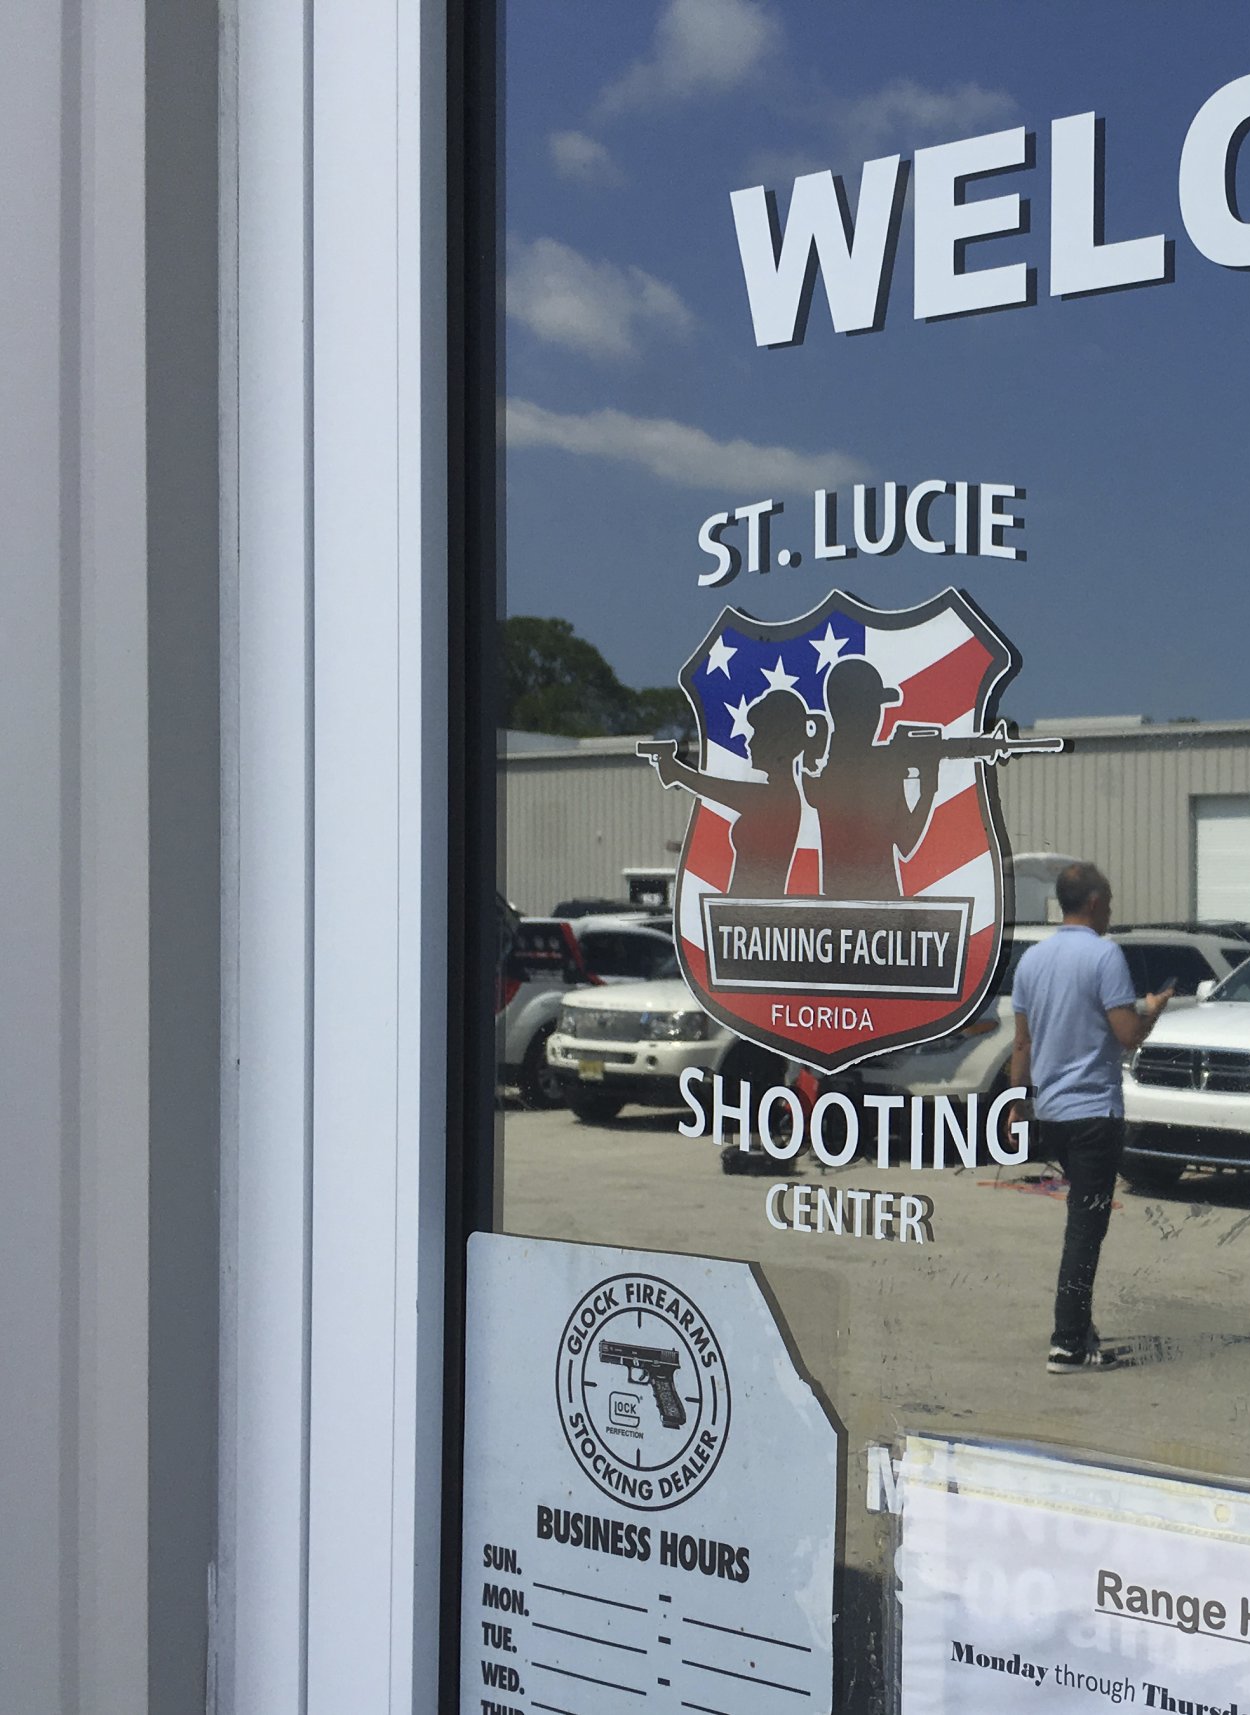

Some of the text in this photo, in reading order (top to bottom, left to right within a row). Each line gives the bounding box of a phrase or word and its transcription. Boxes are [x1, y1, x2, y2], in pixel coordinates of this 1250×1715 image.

[698, 480, 1016, 586] ST. LUCIE
[719, 926, 950, 968] TRAINING FACILITY
[772, 1004, 874, 1032] FLORIDA
[678, 1067, 1030, 1170] SHOOTING
[766, 1184, 924, 1244] CENTER
[567, 1283, 718, 1368] GLOCK FIREARMS
[569, 1413, 719, 1500] STOCKING DEALER
[605, 1426, 644, 1440] PERFECTION
[483, 1543, 522, 1575] SUN.
[537, 1505, 750, 1583] BUSINESS HOURS
[482, 1583, 529, 1617] MON.
[1096, 1570, 1227, 1634] Range
[481, 1621, 517, 1653] TUE.
[481, 1660, 525, 1695] WED.
[950, 1640, 1049, 1686] Monday
[1054, 1665, 1136, 1703] through
[1142, 1682, 1248, 1715] Thursd
